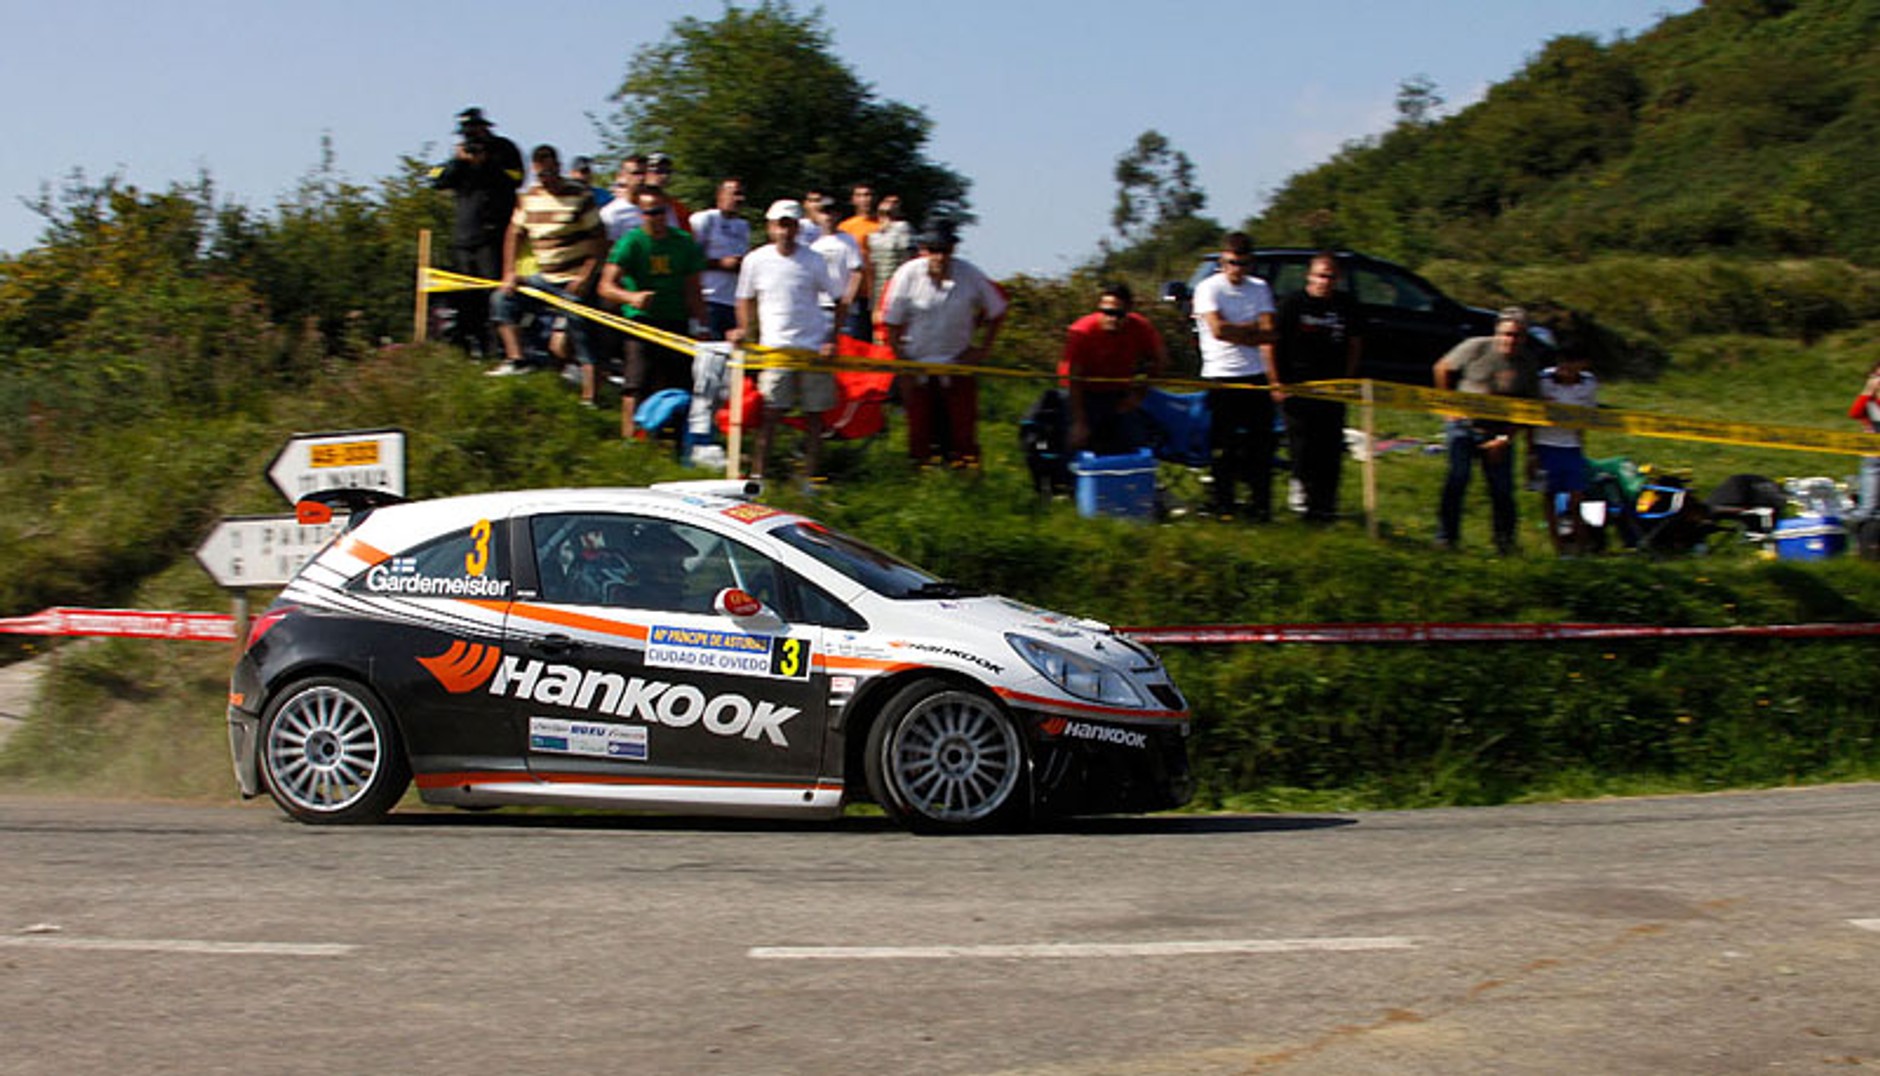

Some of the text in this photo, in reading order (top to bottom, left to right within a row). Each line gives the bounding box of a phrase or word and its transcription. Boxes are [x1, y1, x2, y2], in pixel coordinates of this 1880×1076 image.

[465, 518, 492, 577] 3
[366, 564, 512, 597] Gardemeister
[648, 648, 769, 671] CIUDAD DE OVIEDO
[780, 637, 801, 677] 3
